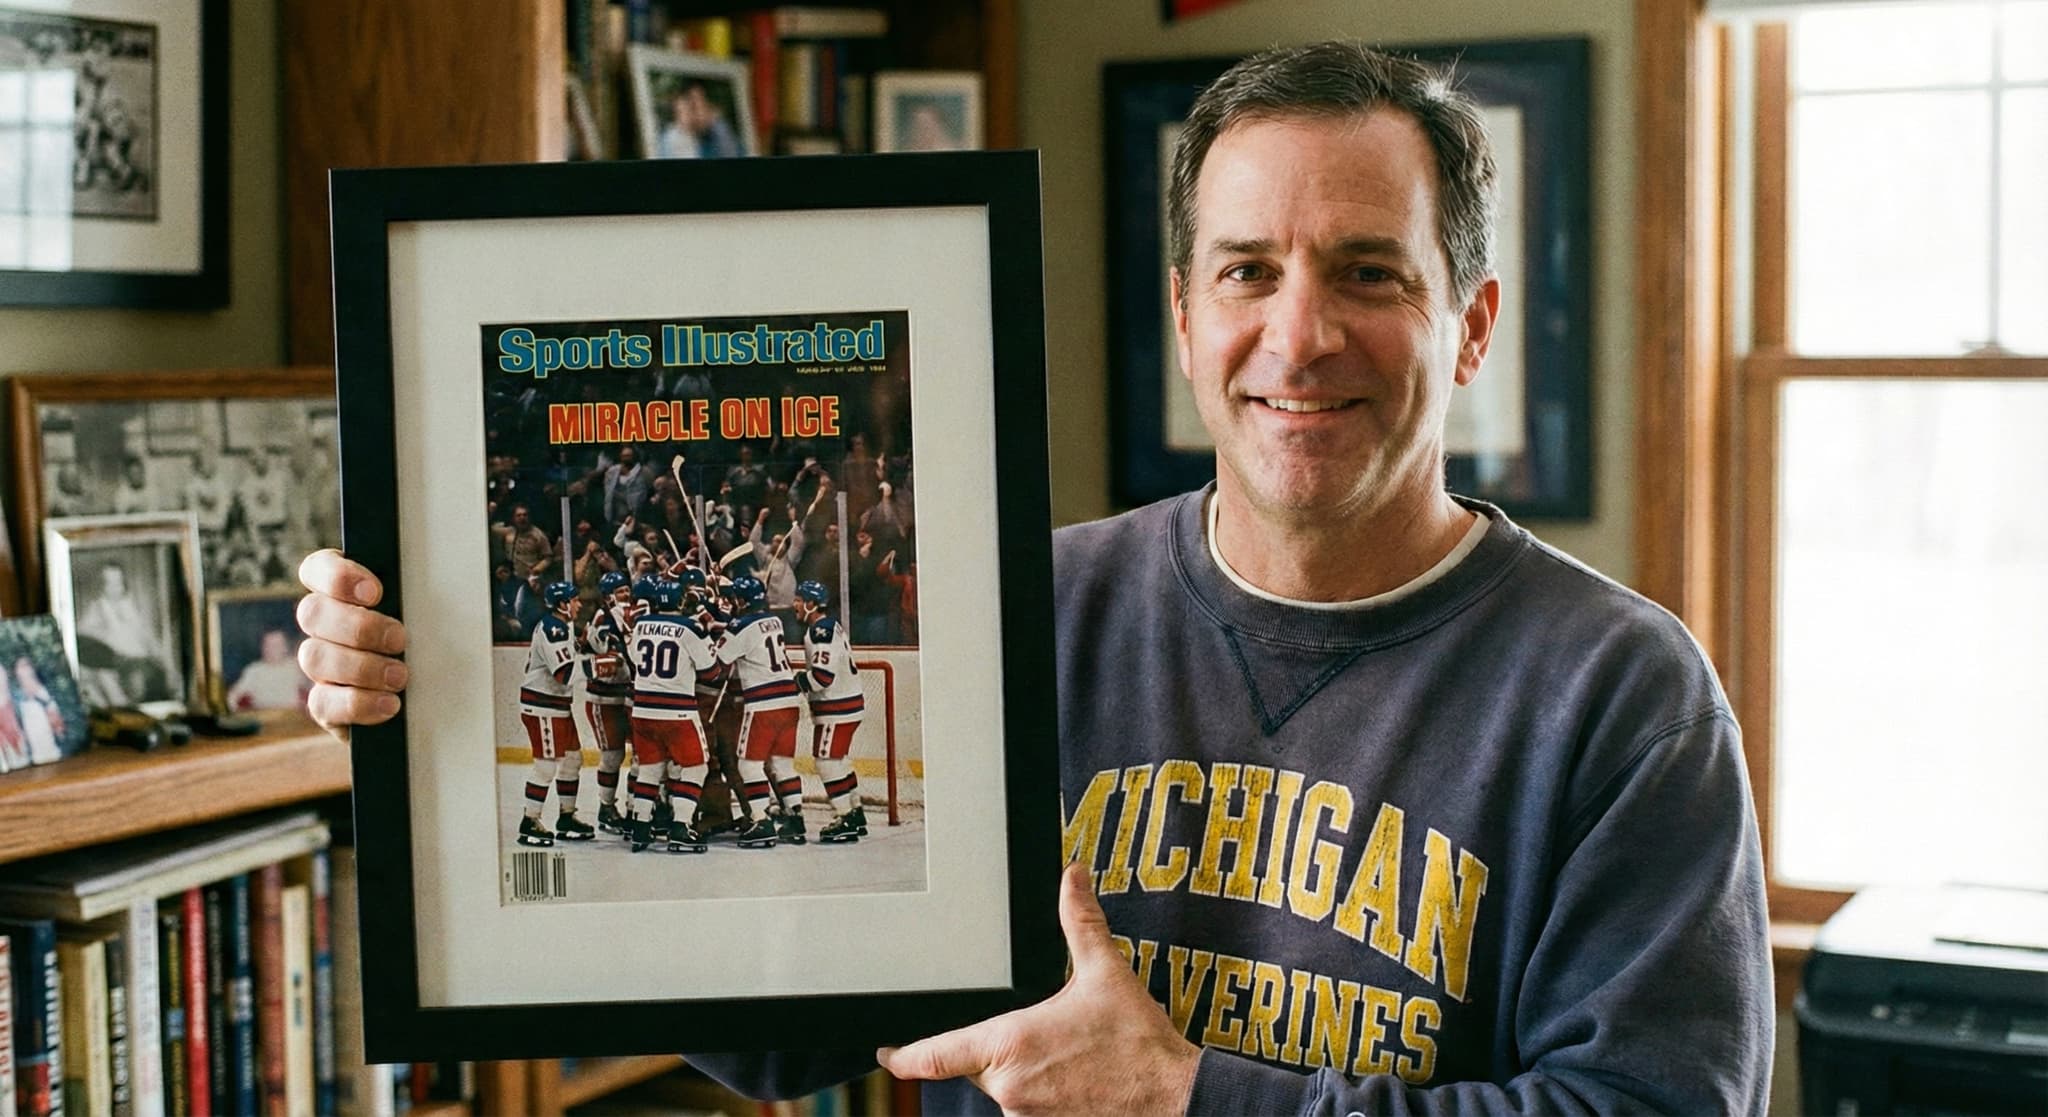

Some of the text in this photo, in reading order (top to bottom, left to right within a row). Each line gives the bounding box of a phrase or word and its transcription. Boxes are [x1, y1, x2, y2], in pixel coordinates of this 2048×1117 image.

[498, 320, 885, 379] Sports Illustrated
[548, 395, 840, 444] MIRACLE ON ICE
[637, 639, 680, 679] 30
[1066, 934, 1442, 1084] LVERINES
